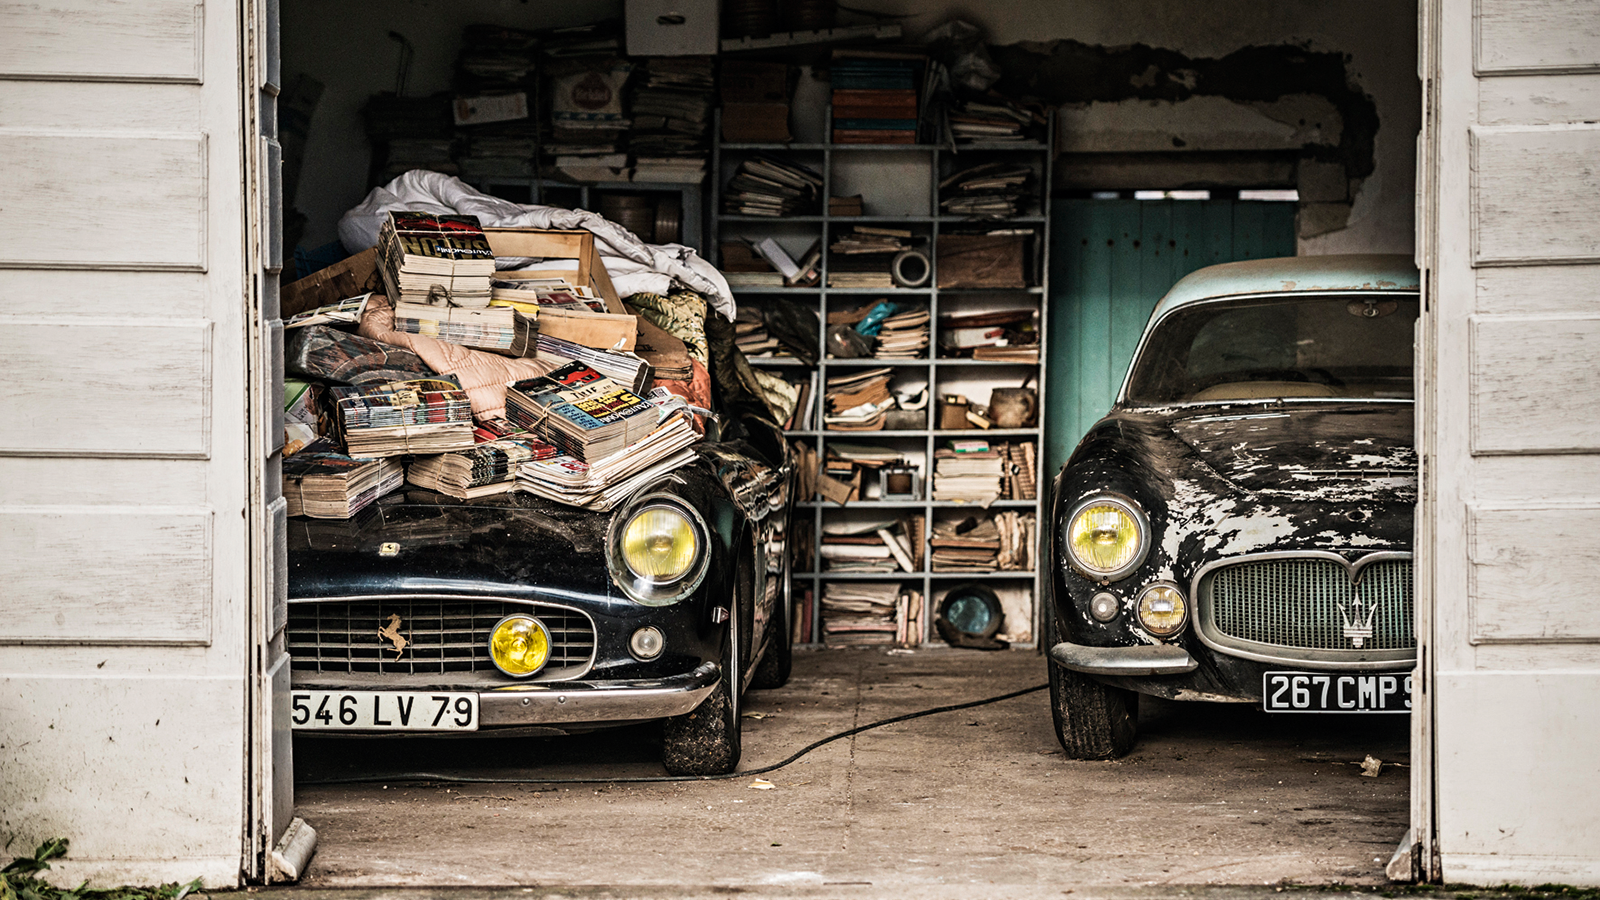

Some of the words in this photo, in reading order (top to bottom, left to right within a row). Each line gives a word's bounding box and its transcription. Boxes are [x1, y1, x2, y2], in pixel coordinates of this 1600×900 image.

[292, 695, 358, 726] 546
[373, 695, 415, 727] LV
[431, 696, 473, 728] 79
